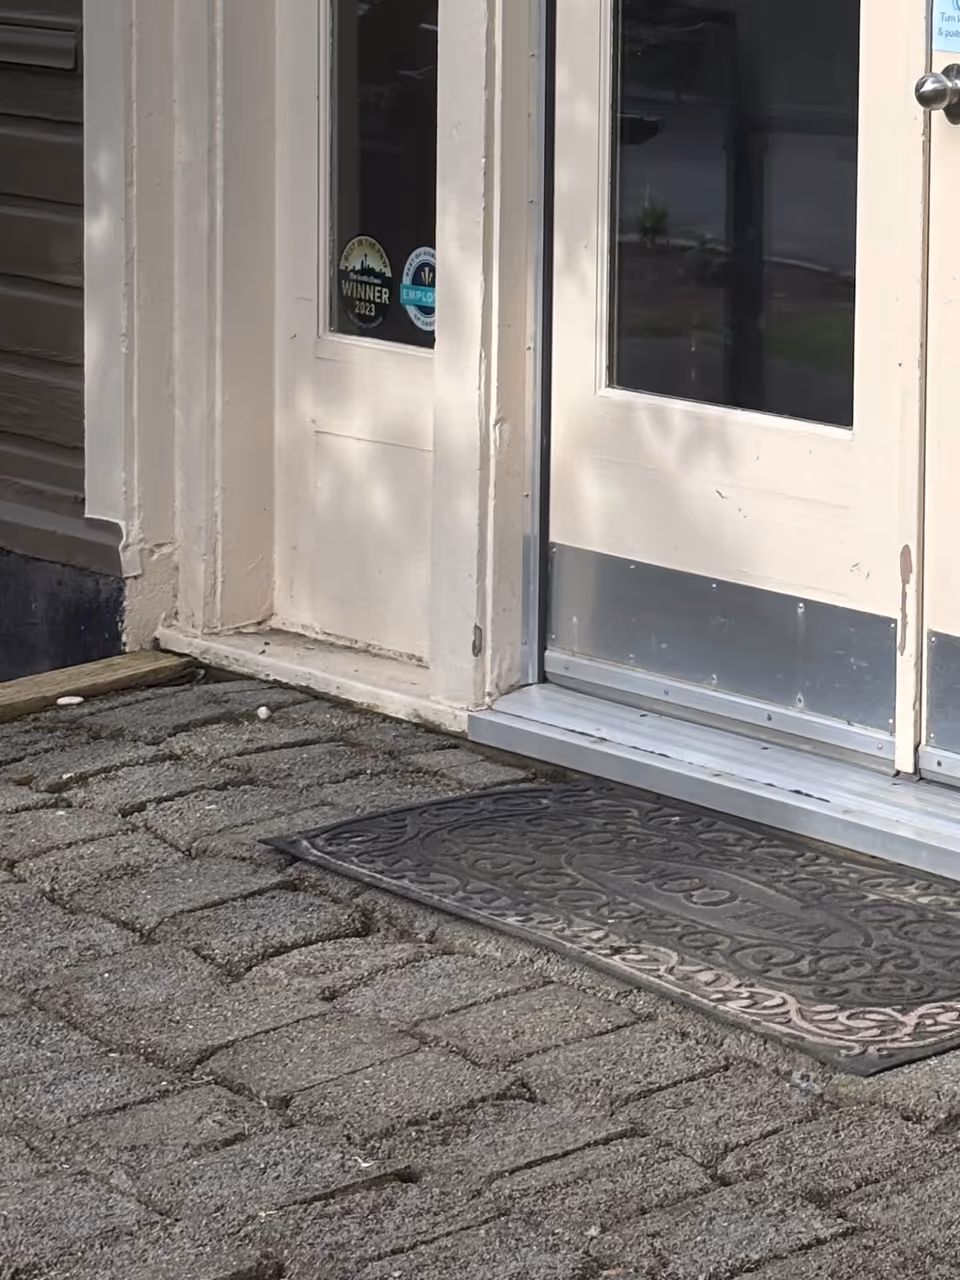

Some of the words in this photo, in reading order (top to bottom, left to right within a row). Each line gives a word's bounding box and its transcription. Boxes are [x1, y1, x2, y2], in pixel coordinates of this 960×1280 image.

[940, 11, 956, 22] Turn
[341, 280, 390, 305] WINNER
[402, 288, 437, 303] EMPLO
[355, 300, 376, 317] 2023
